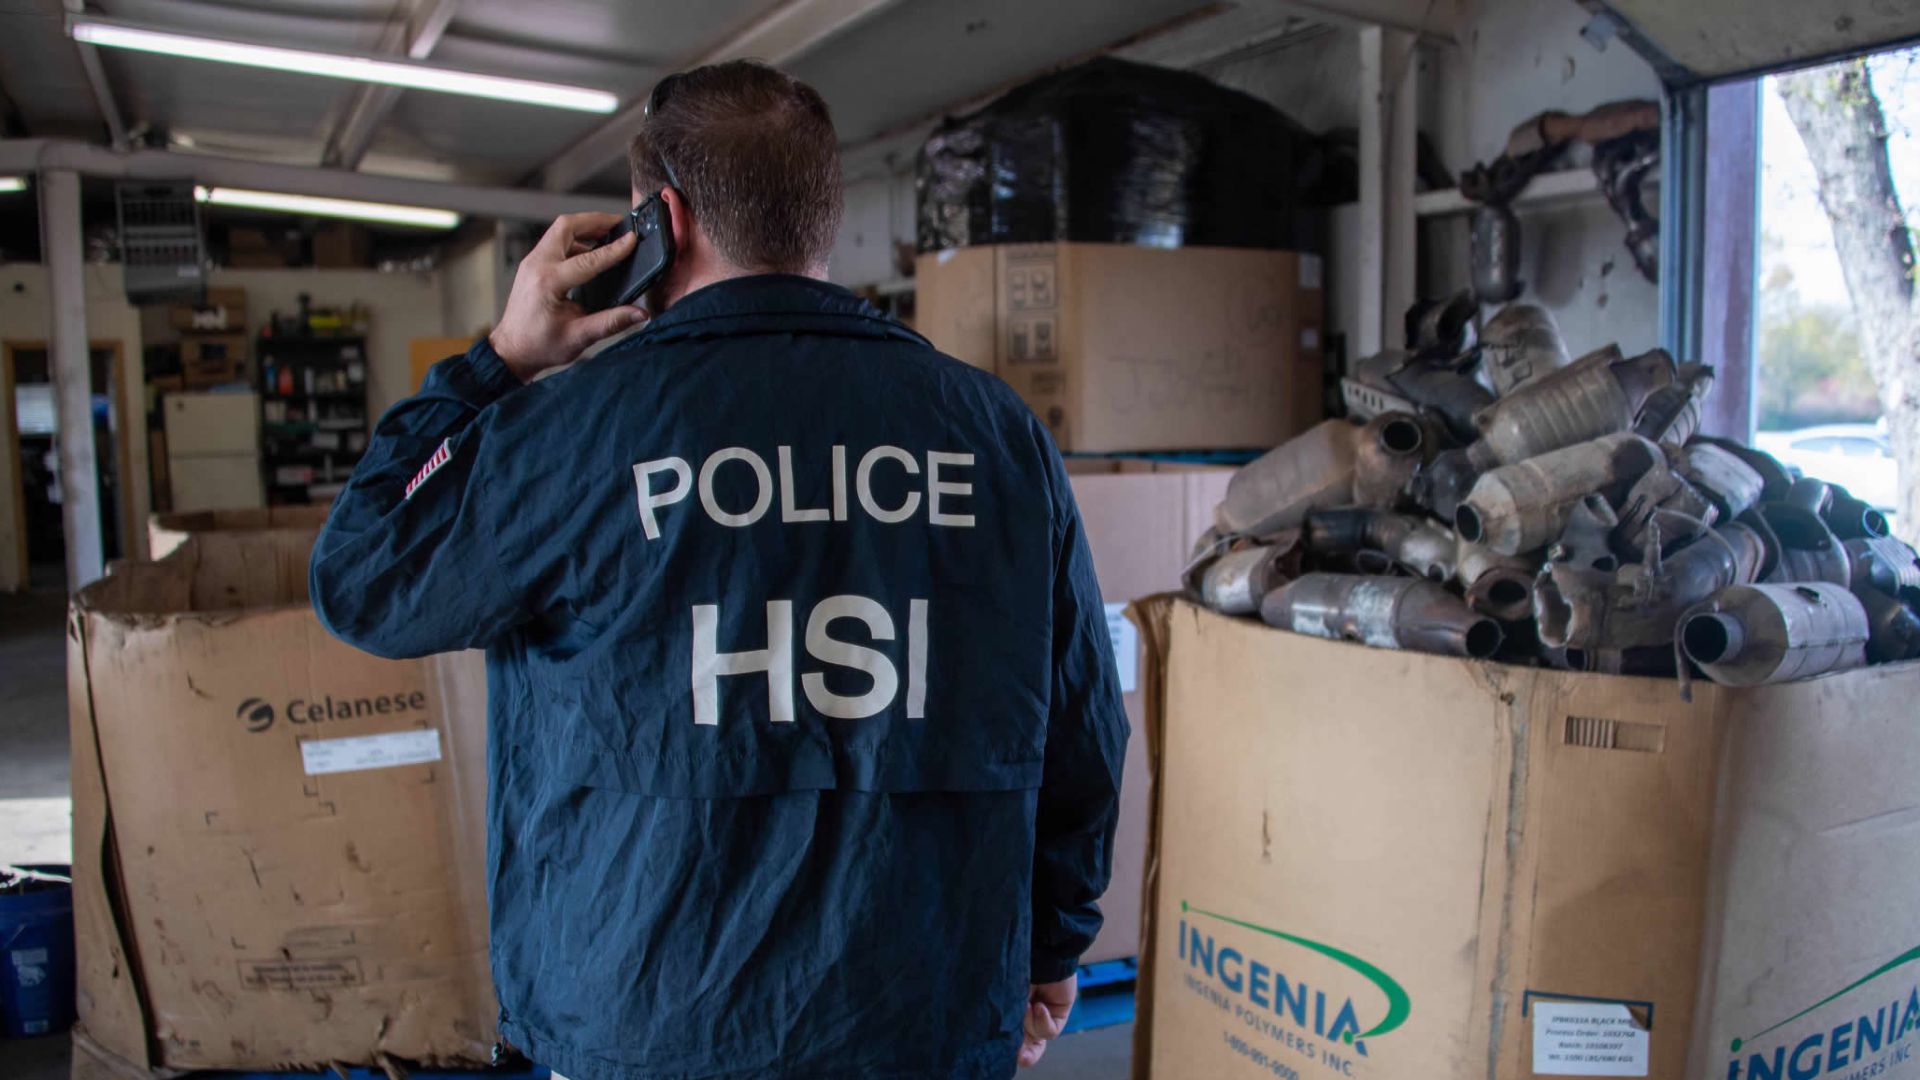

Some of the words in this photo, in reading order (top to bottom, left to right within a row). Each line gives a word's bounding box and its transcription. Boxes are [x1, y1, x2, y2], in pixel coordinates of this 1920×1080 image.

[633, 444, 976, 540] POLICE
[691, 594, 929, 725] HSI
[286, 691, 426, 725] Celanese
[1178, 918, 1369, 1058] INGENIA
[1235, 1003, 1316, 1059] POLYMERS
